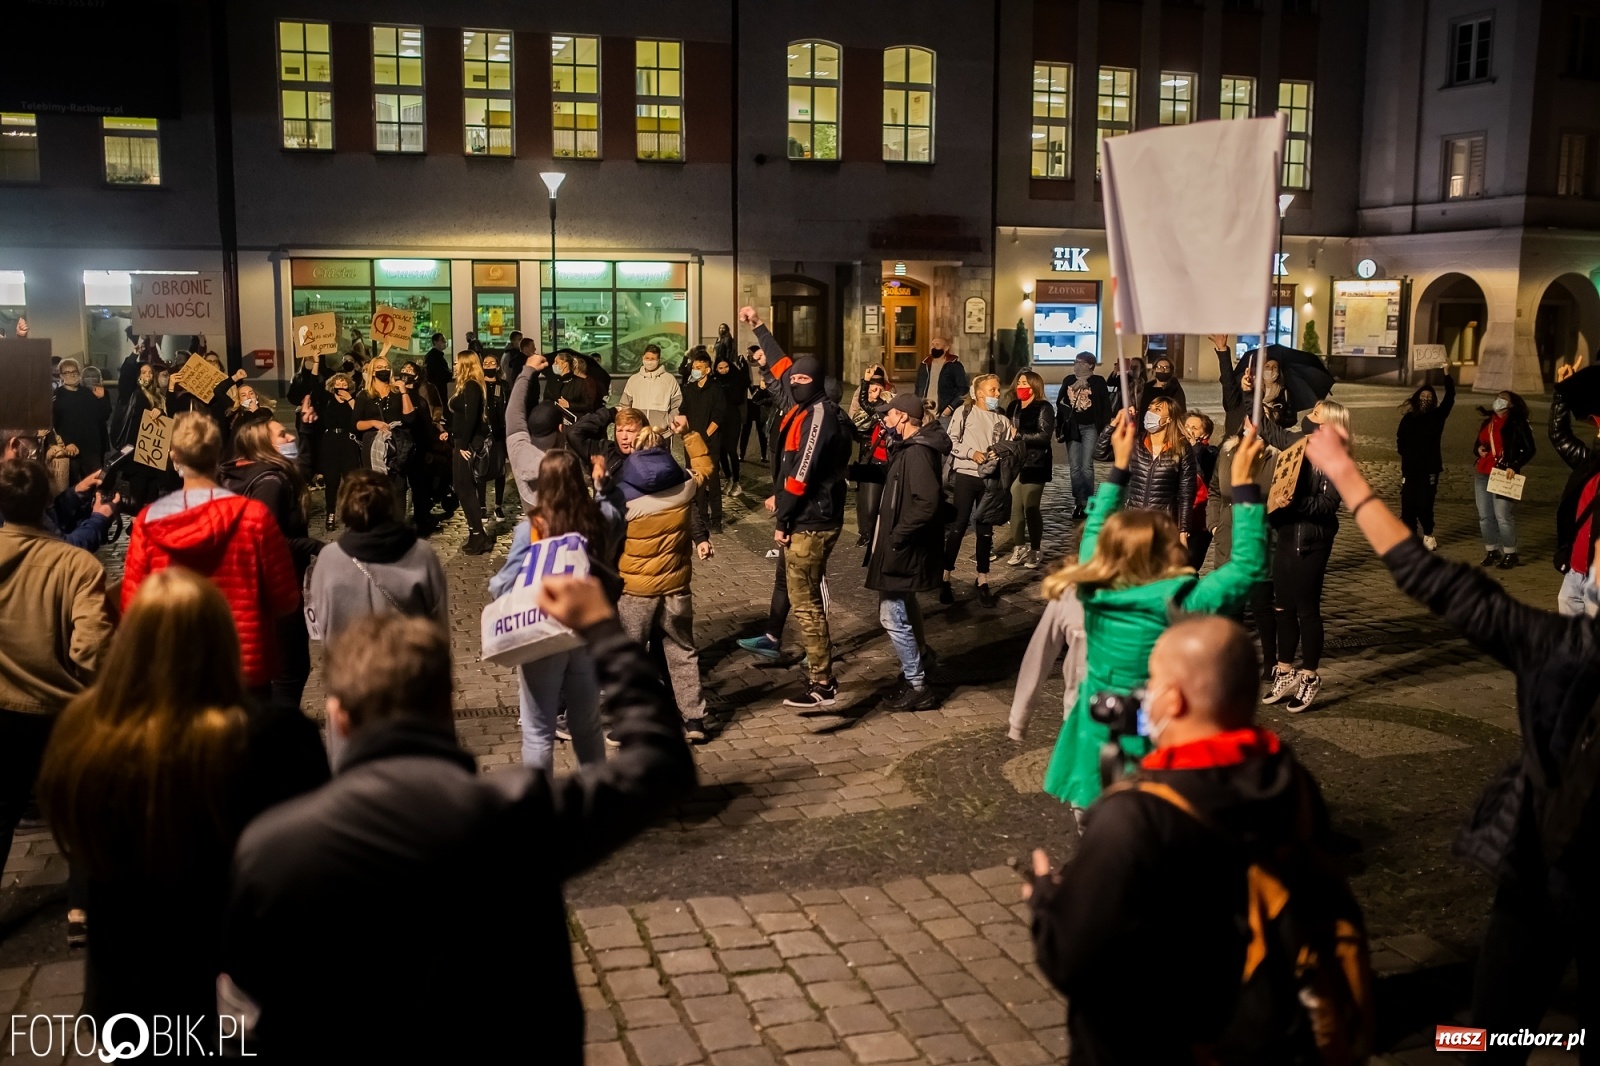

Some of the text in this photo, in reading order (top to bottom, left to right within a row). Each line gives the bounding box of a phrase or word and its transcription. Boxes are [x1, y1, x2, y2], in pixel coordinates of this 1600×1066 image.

[20, 101, 124, 114] Telebimy-Raciborz.pl
[312, 265, 357, 279] Ciasta
[152, 279, 213, 295] OBRONIE
[1048, 286, 1086, 294] ZŁOTNIK
[137, 298, 210, 318] WOLNOŚCI
[139, 421, 154, 453] PIS
